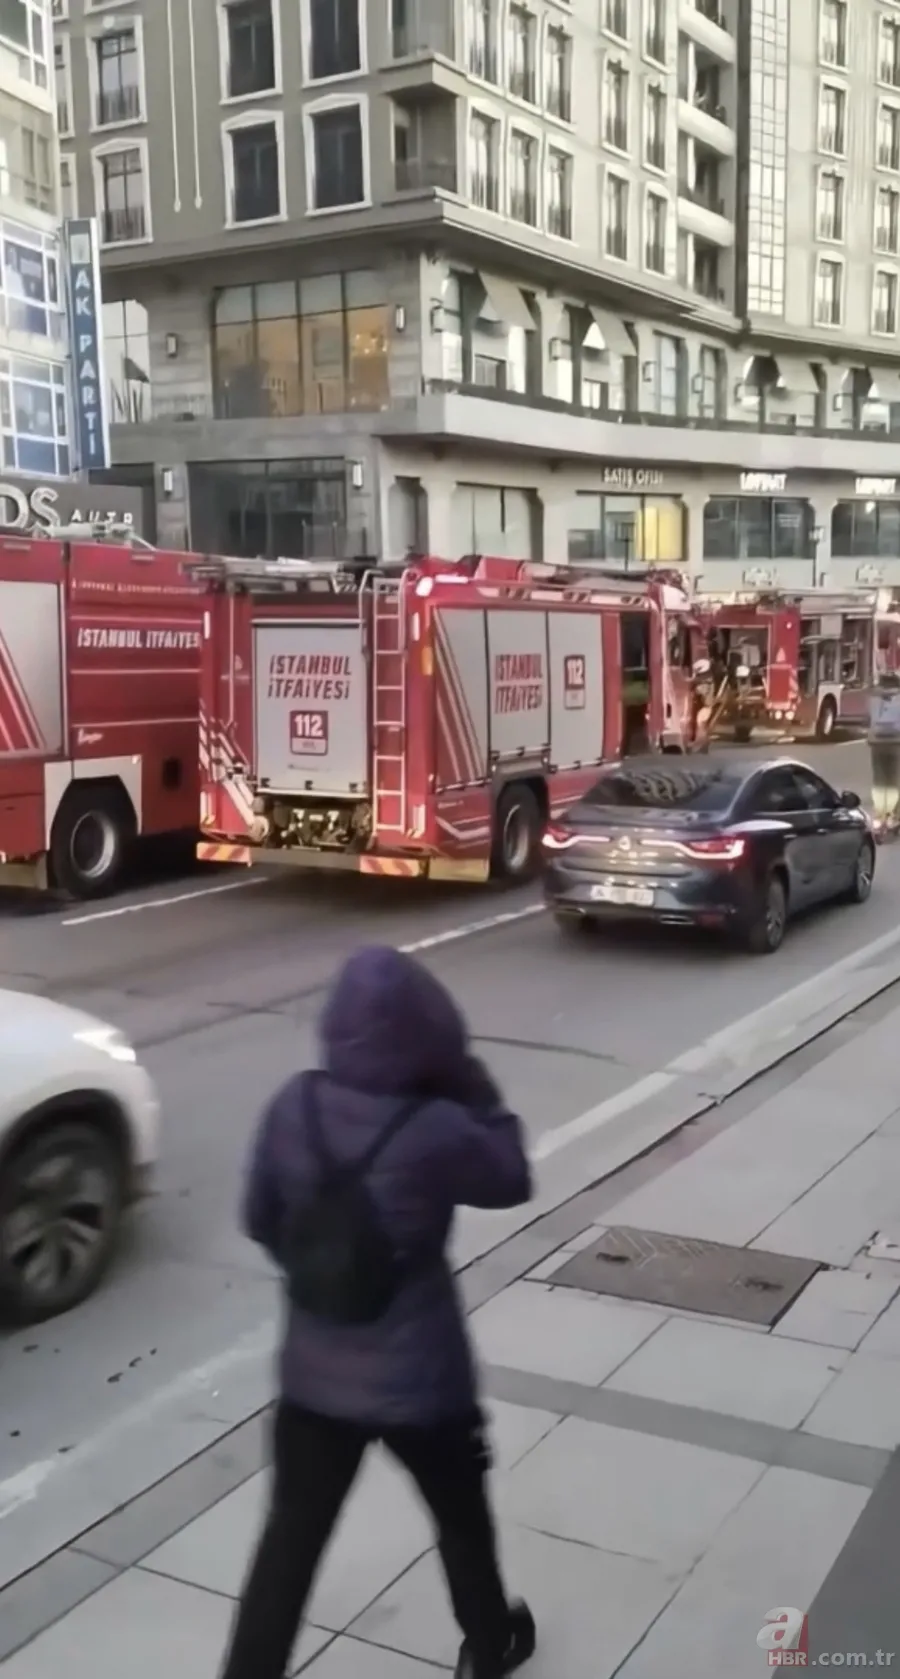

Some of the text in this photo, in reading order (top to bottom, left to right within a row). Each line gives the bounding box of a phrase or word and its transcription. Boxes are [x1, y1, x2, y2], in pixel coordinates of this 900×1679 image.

[75, 268, 92, 316] AK
[567, 659, 583, 685] 112
[294, 713, 324, 737] 112
